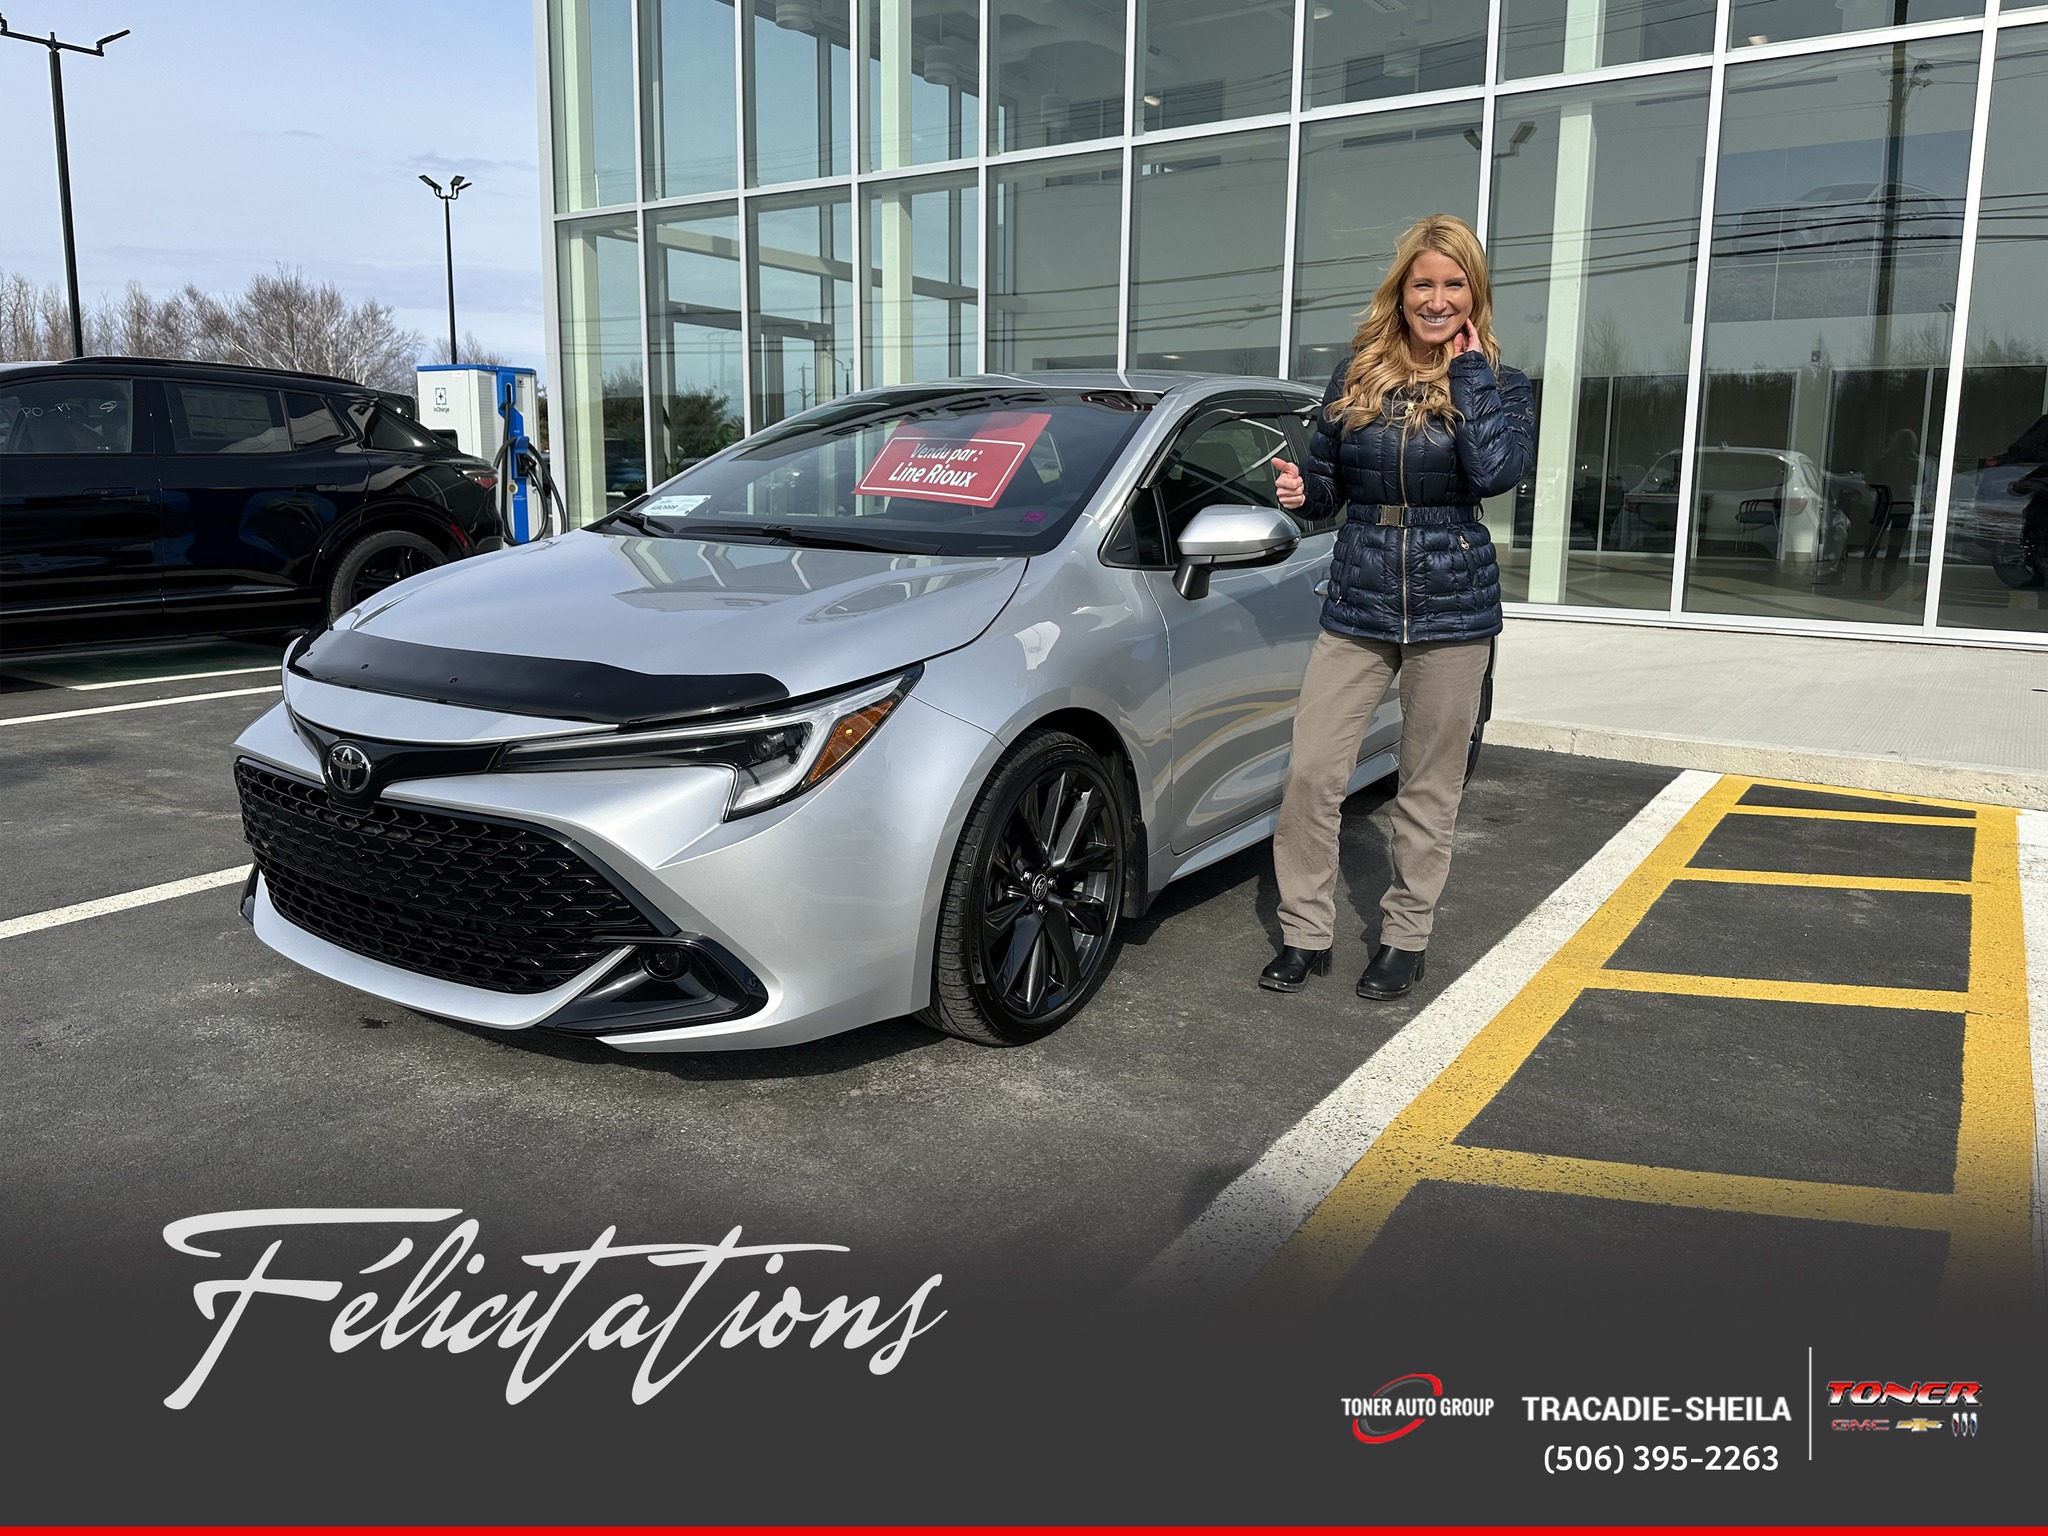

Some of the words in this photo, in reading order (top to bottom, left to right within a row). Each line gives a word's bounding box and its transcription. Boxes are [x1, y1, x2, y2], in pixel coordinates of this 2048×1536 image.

[910, 443, 951, 459] Vendu
[888, 462, 926, 483] Line
[922, 463, 978, 488] Rioux
